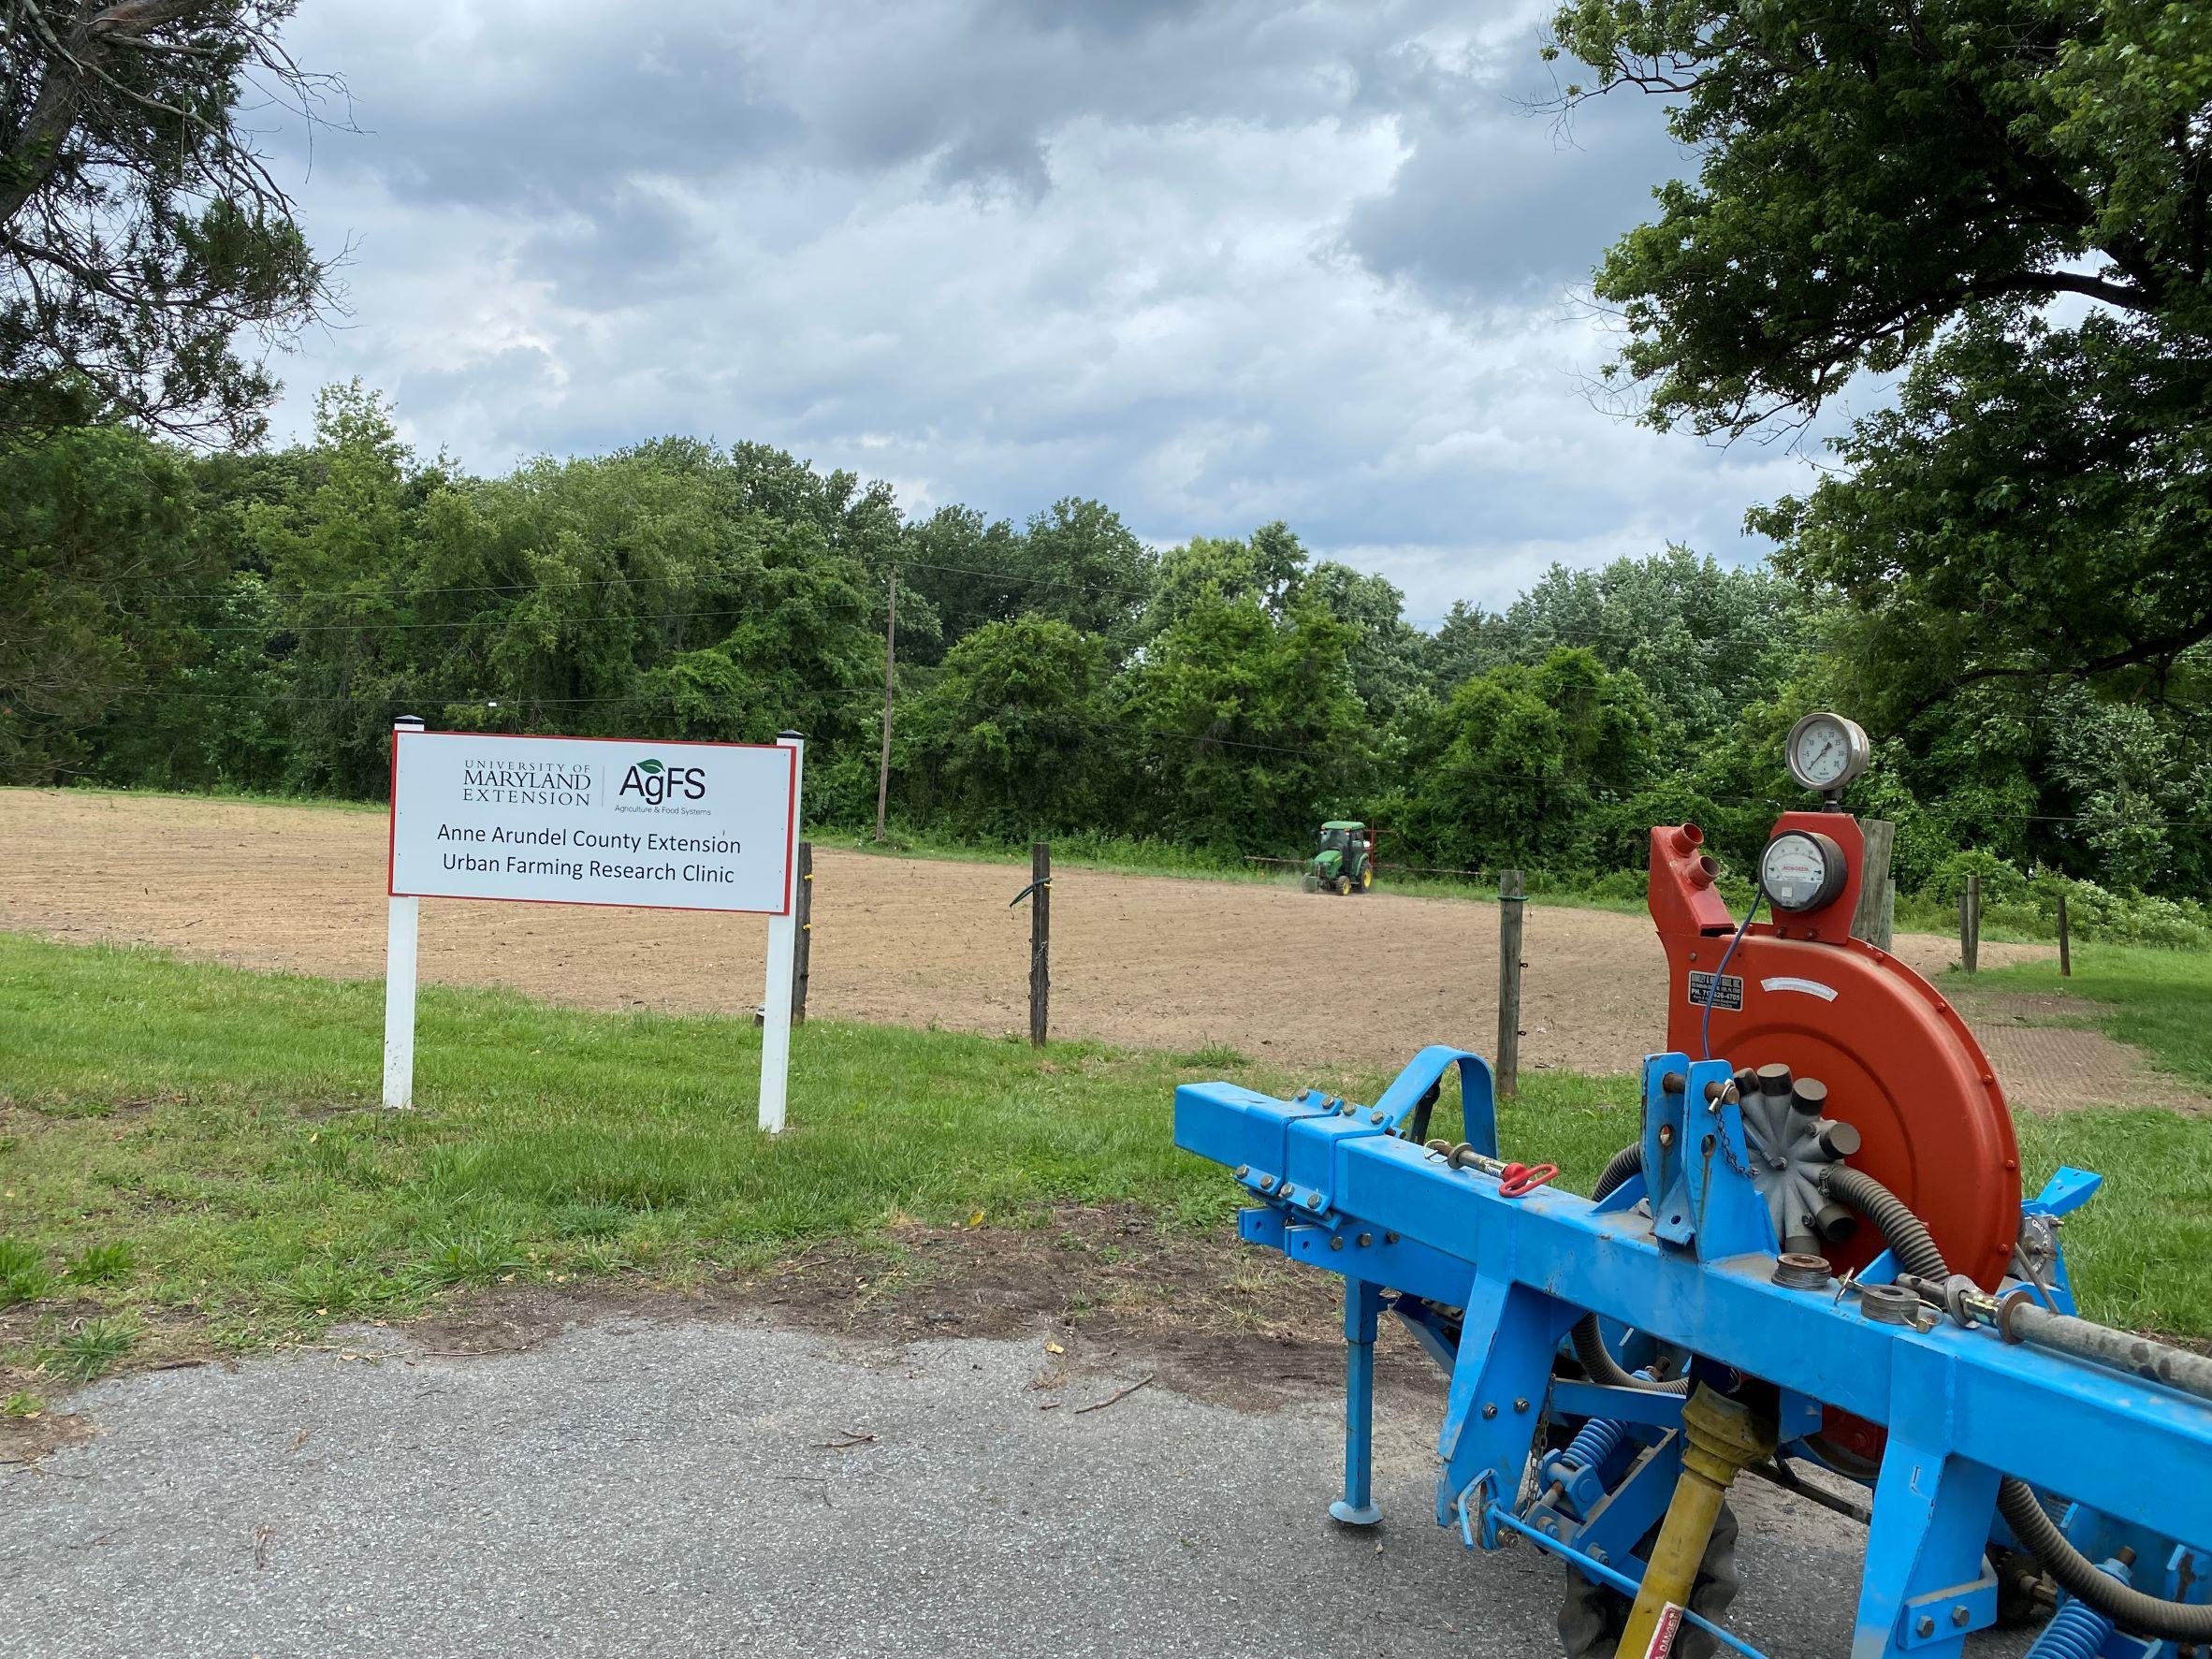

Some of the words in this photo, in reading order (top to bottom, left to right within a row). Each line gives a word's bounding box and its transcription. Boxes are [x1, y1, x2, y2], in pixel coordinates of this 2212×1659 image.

[465, 760, 565, 772] UNIVERSITY
[573, 764, 590, 773] OF
[463, 769, 591, 791] MARYLAND
[618, 765, 706, 805] AgFS
[462, 788, 590, 806] EXTENSION
[614, 804, 652, 813] Agriculture
[662, 806, 679, 815] Food
[680, 808, 711, 816] Systems
[437, 823, 486, 842] Anne
[491, 826, 566, 846] Arundel
[573, 830, 642, 852] County
[648, 833, 741, 854] Extension
[444, 852, 500, 872] Urban
[506, 856, 584, 880] Farming
[589, 860, 676, 880] Research
[683, 864, 735, 883] Clinic
